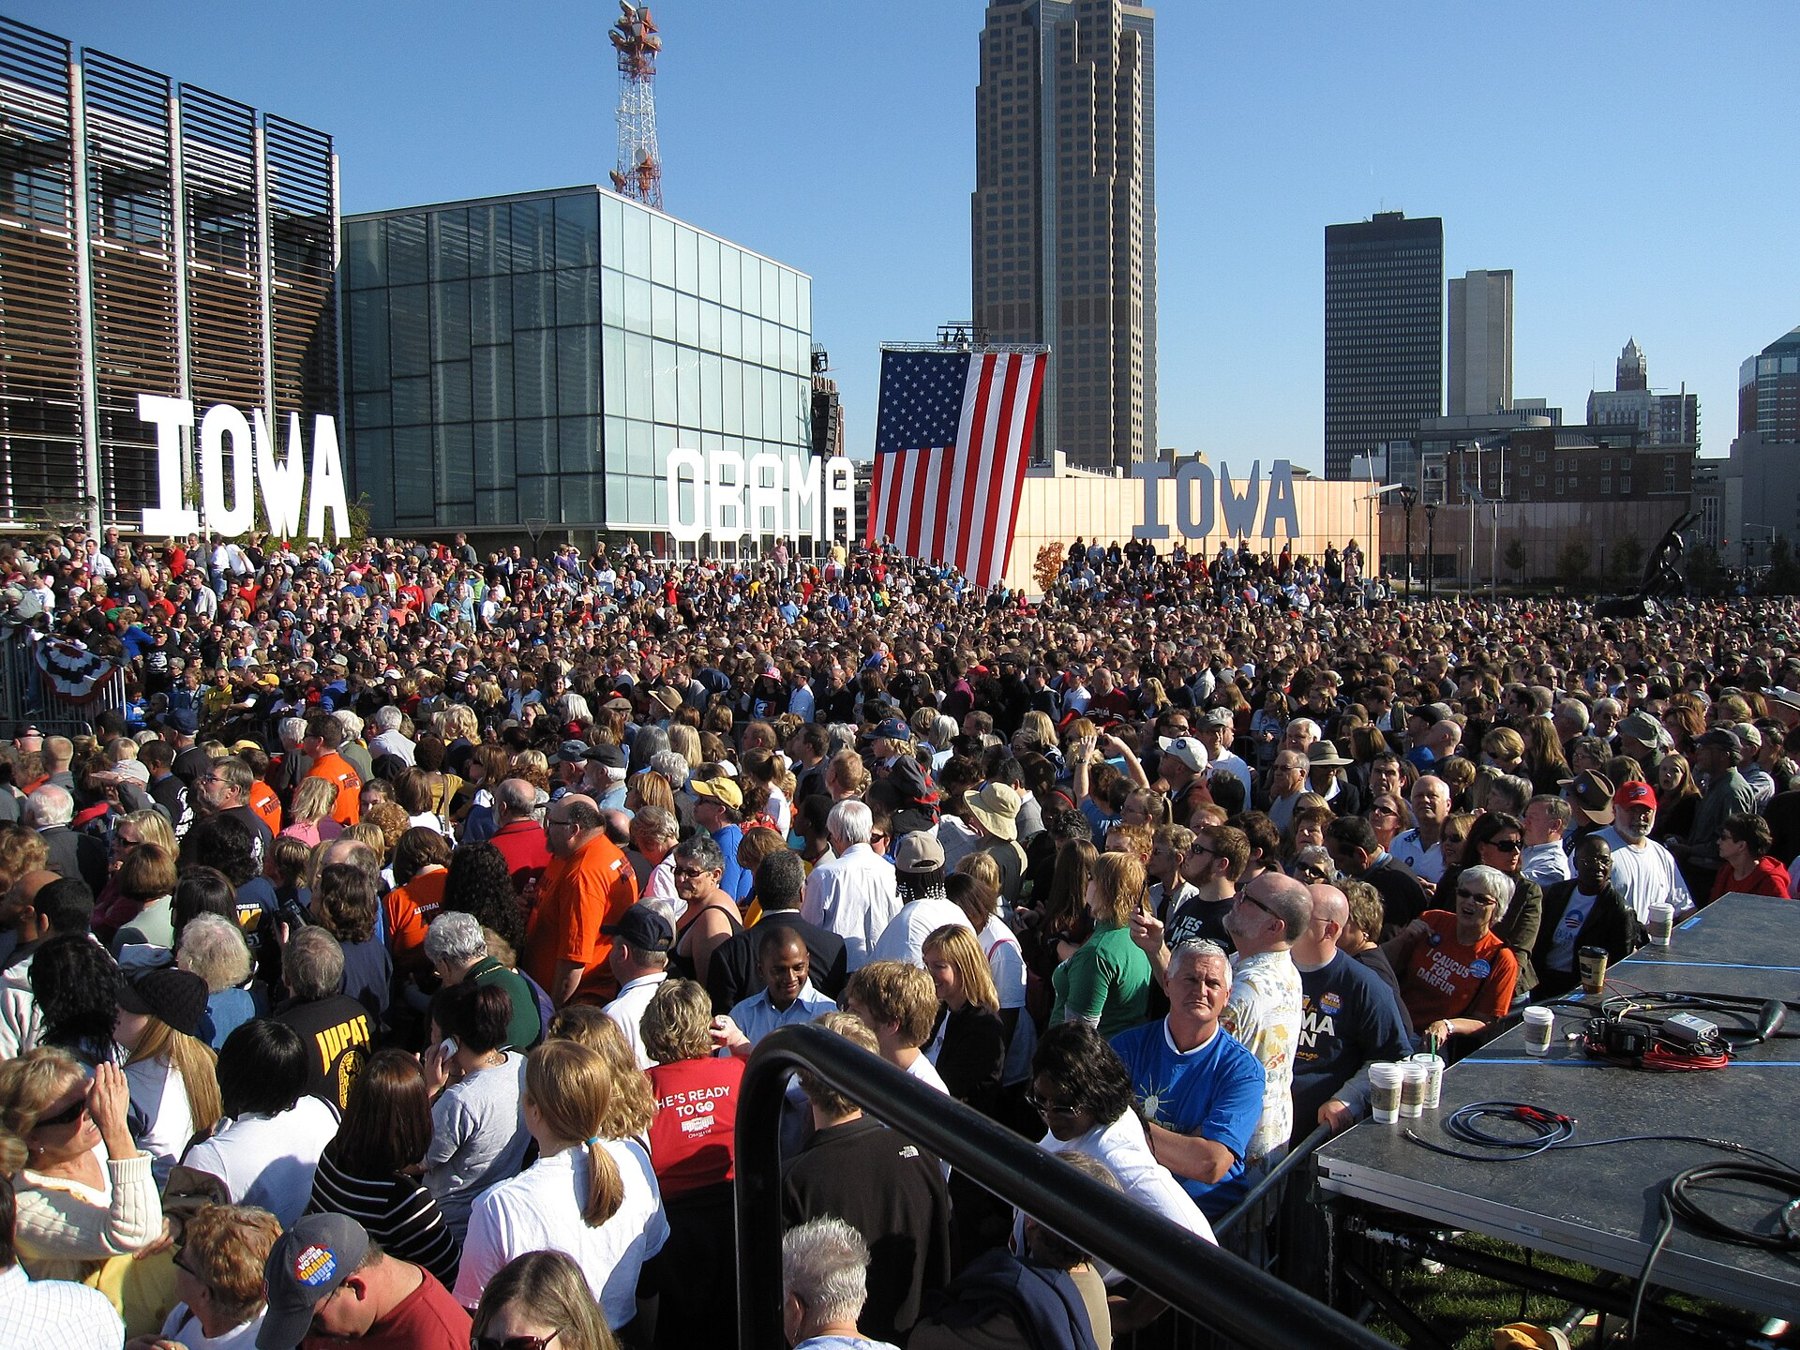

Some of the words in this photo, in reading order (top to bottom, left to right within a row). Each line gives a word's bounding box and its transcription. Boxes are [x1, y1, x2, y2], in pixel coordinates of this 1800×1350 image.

[138, 393, 351, 538] IOWA
[667, 447, 856, 542] OBAMA
[1131, 459, 1300, 539] IOWA
[1181, 915, 1203, 932] YES
[1426, 948, 1434, 957] I
[1432, 951, 1470, 978] CAUCUS
[1430, 963, 1451, 981] FOR
[1416, 967, 1456, 996] DARFUR
[655, 1092, 686, 1111] HE'S
[688, 1086, 730, 1102] READY
[676, 1104, 695, 1117] TO
[695, 1100, 715, 1113] GO
[297, 1245, 316, 1263] UNION
[297, 1248, 324, 1271] VOTER
[300, 1251, 333, 1280] OBAMA
[308, 1259, 336, 1286] BIDEN
